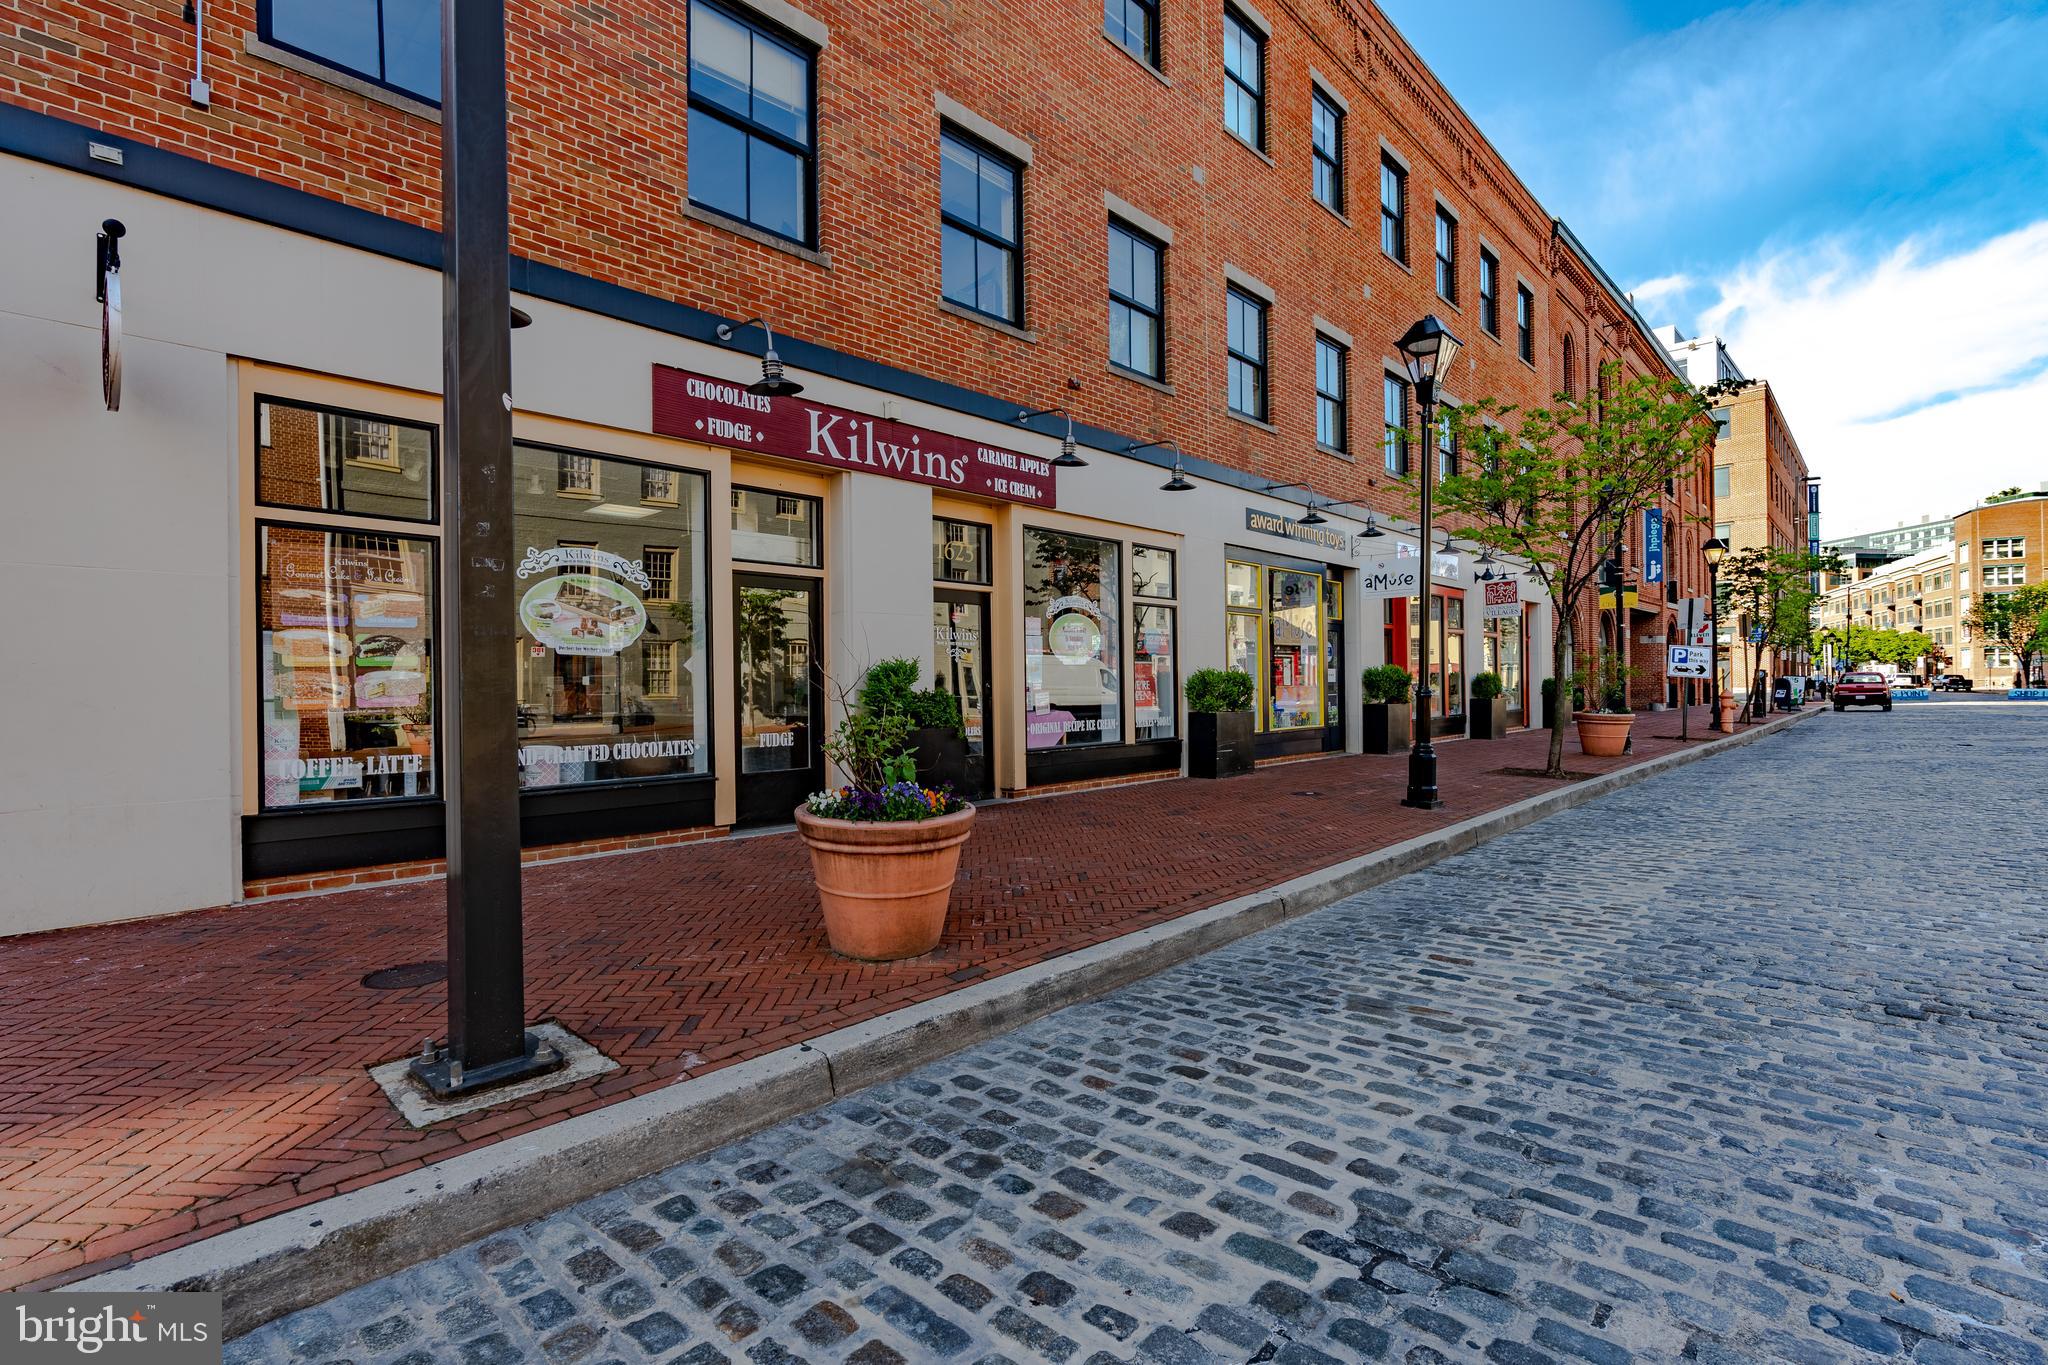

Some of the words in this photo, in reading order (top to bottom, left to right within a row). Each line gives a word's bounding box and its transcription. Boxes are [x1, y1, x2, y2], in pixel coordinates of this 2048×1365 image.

[686, 378, 772, 414] CHOCOLATES
[706, 417, 752, 443] FUDGE
[804, 408, 964, 484] Kilwins
[977, 447, 1018, 471] CARAMEL
[1019, 456, 1051, 477] APPLES
[994, 477, 1008, 494] ICE
[1009, 481, 1037, 499] CREAM
[1250, 514, 1285, 534] award
[1285, 520, 1325, 546] winning
[1326, 528, 1345, 550] toys
[335, 557, 368, 568] Kilwins
[564, 549, 610, 562] Kilwins
[936, 541, 974, 564] 1625
[286, 562, 325, 580] Gourmet
[327, 566, 351, 581] Cake
[1364, 573, 1414, 591] aMuse
[936, 626, 977, 640] Kilwins
[1674, 649, 1687, 662] P
[1030, 721, 1062, 735] ORIGINAL
[1063, 720, 1086, 732] RECIPE
[1086, 719, 1096, 731] ICE
[1096, 718, 1116, 730] CREAM
[612, 739, 695, 760] CHOCOLATES
[759, 732, 794, 748] FUDGE
[279, 756, 354, 780] COFFEE
[366, 754, 423, 776] LATTE
